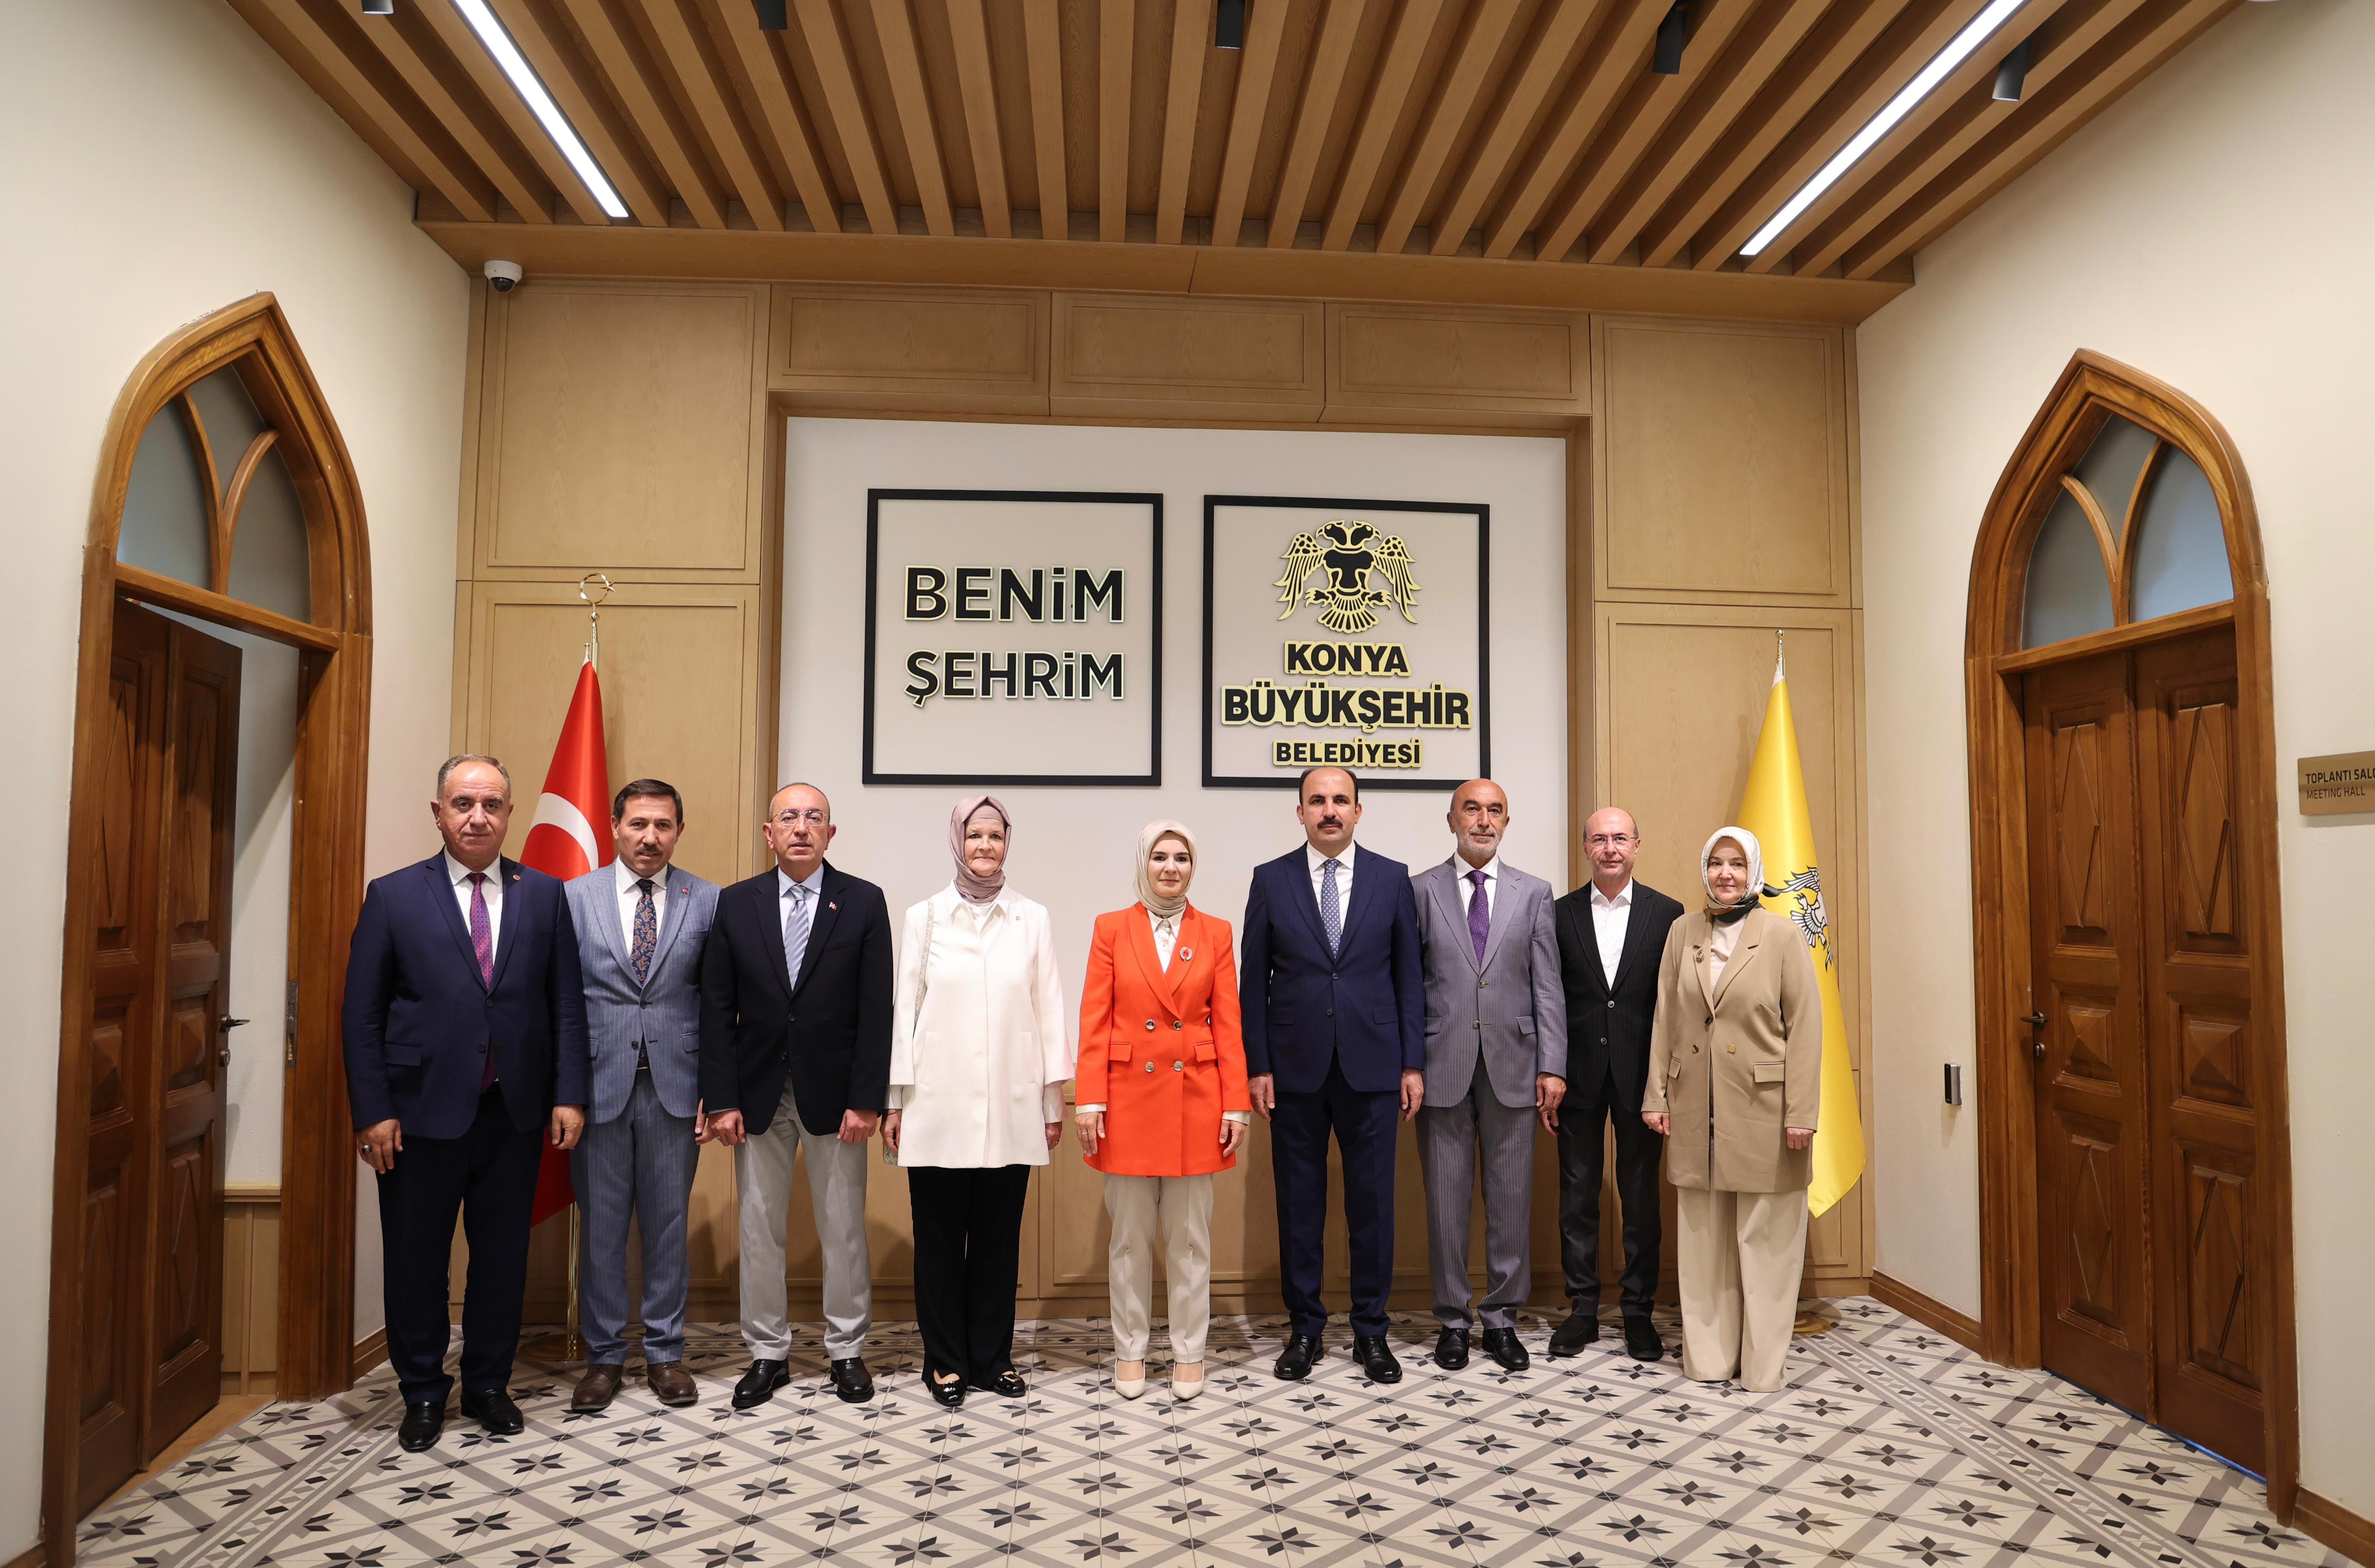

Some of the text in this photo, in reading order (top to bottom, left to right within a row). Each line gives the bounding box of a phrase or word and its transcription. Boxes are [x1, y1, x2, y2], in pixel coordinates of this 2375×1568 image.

[1287, 643, 1409, 673] KONYA
[1225, 681, 1470, 730] BÜYÜKŞEHİR
[1276, 738, 1420, 764] BELEDİYESİ
[2306, 770, 2351, 784] TOPLANTI
[2307, 786, 2365, 800] MEETING HALL
